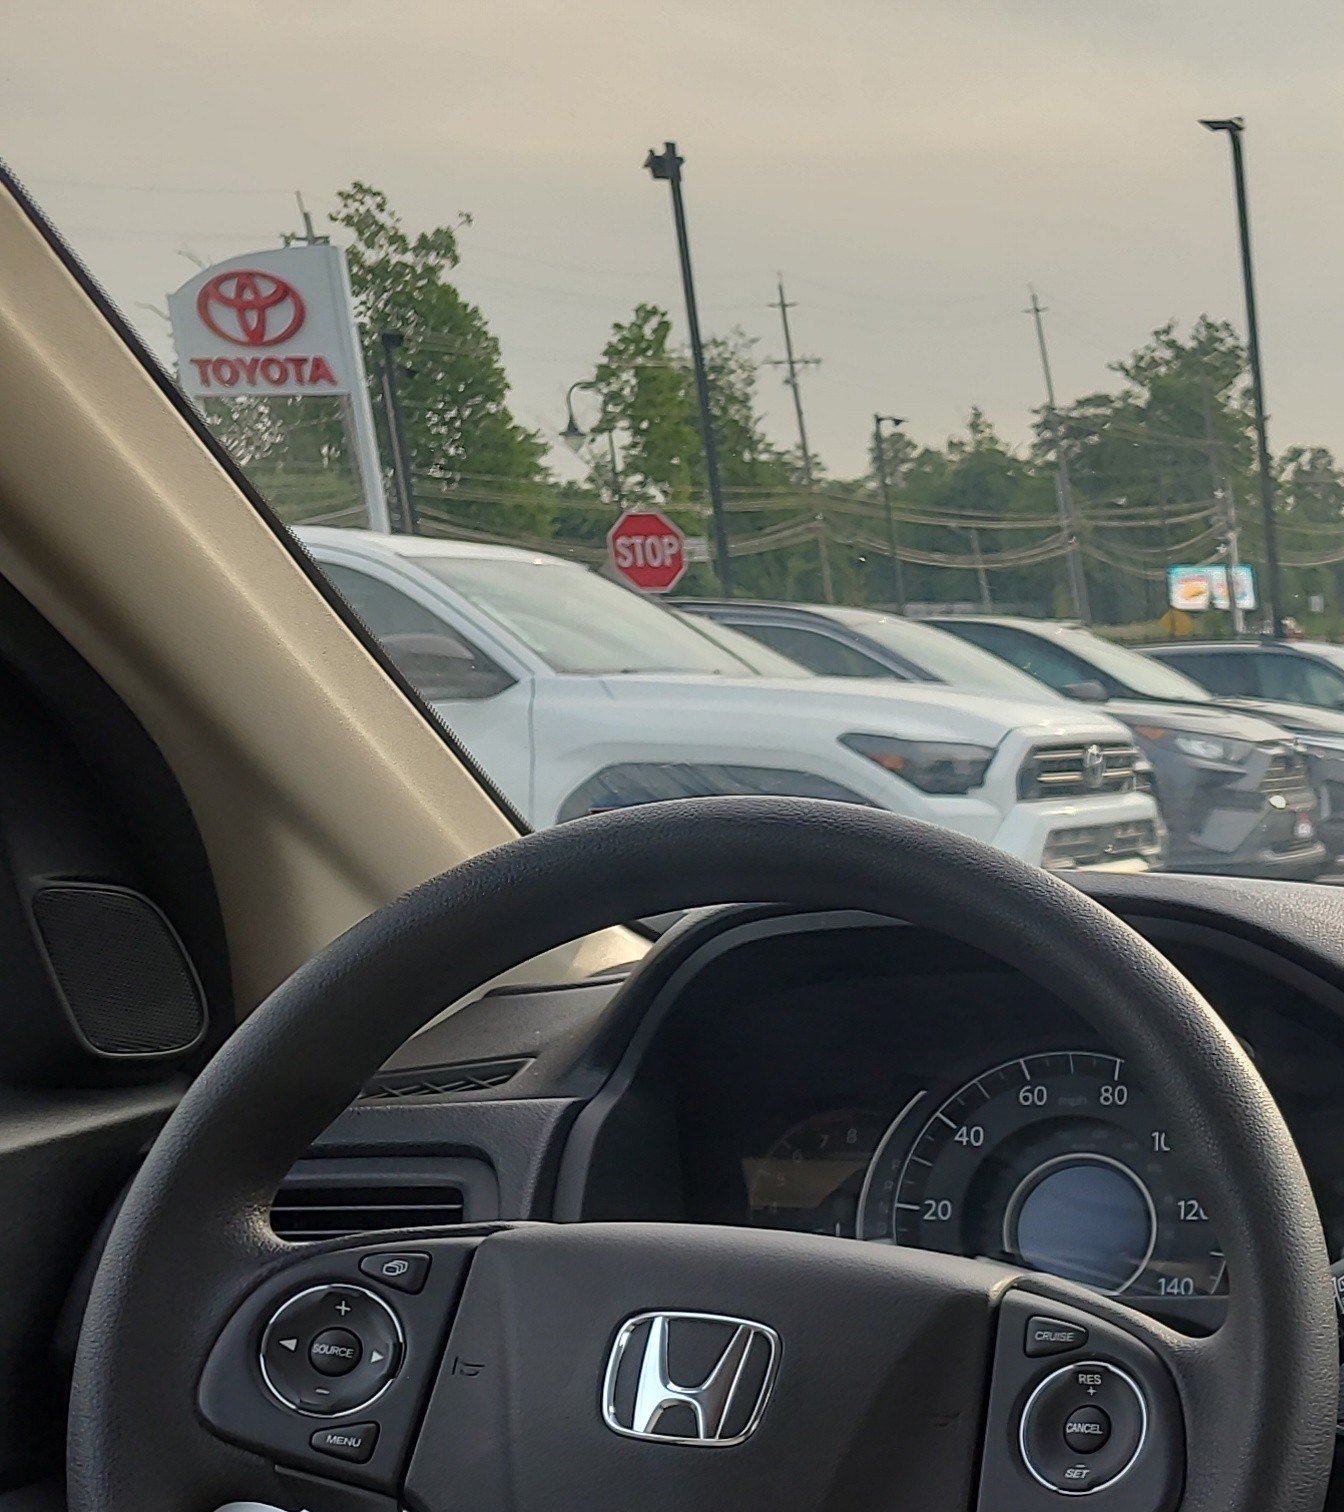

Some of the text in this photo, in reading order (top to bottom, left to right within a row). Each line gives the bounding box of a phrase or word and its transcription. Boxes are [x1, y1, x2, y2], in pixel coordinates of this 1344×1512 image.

[190, 356, 338, 388] TOYOTA
[615, 534, 680, 568] STOP
[1019, 1086, 1047, 1105] 60
[1100, 1086, 1128, 1105] 80
[954, 1126, 984, 1146] 40
[923, 1200, 952, 1220] 20
[1158, 1277, 1194, 1295] 140
[1034, 1330, 1075, 1342] CRUISE
[312, 1343, 355, 1359] SOURCE
[1078, 1373, 1102, 1385] RES
[1065, 1422, 1104, 1434] CANCEL
[326, 1434, 362, 1448] MENU
[1064, 1468, 1091, 1479] SET
